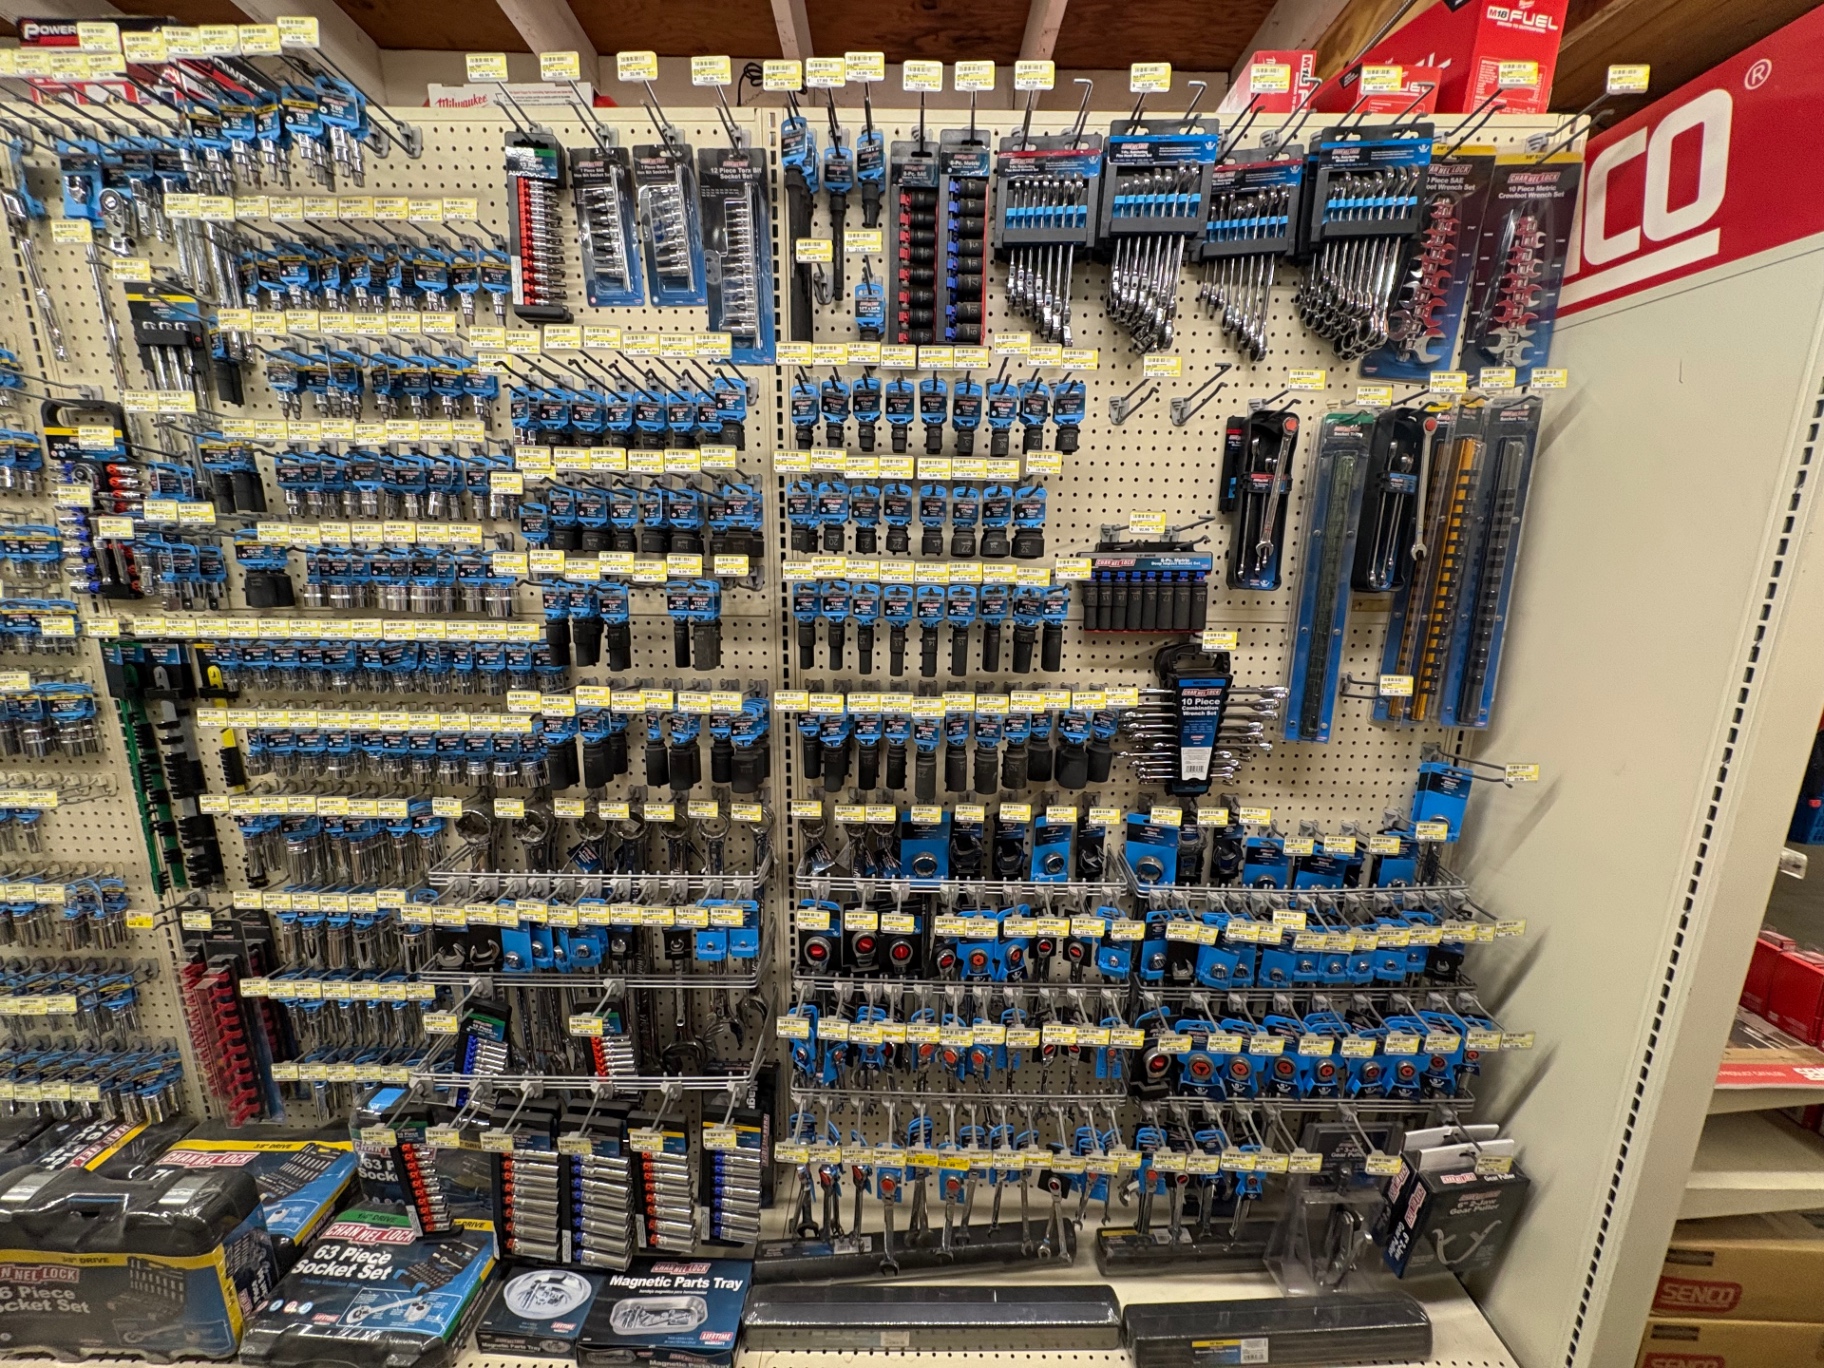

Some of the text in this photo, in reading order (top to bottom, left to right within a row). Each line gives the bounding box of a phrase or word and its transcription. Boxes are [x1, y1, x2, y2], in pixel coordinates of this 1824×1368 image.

[1489, 8, 1559, 31] M18 FUEL
[1182, 698, 1221, 706] 10 Piece
[156, 1151, 260, 1169] CHANNELLOCK
[364, 1158, 382, 1171] 63
[358, 1167, 399, 1182] Sock
[358, 1212, 398, 1223] 1/4" DRIVE
[1450, 1207, 1472, 1215] Gear
[463, 1220, 485, 1229] DRIVE
[321, 1223, 416, 1245] CHANNELLOCK
[313, 1245, 392, 1266] 63 Piece
[291, 1259, 393, 1281] Socket Set
[609, 1275, 744, 1292] Magnetic Parts Tray
[0, 1286, 76, 1300] 6 Piece
[1661, 1283, 1735, 1304] SENCO
[56, 1300, 91, 1314] Set
[702, 1332, 732, 1341] LIFETIME
[649, 1359, 686, 1368] Magnetic
